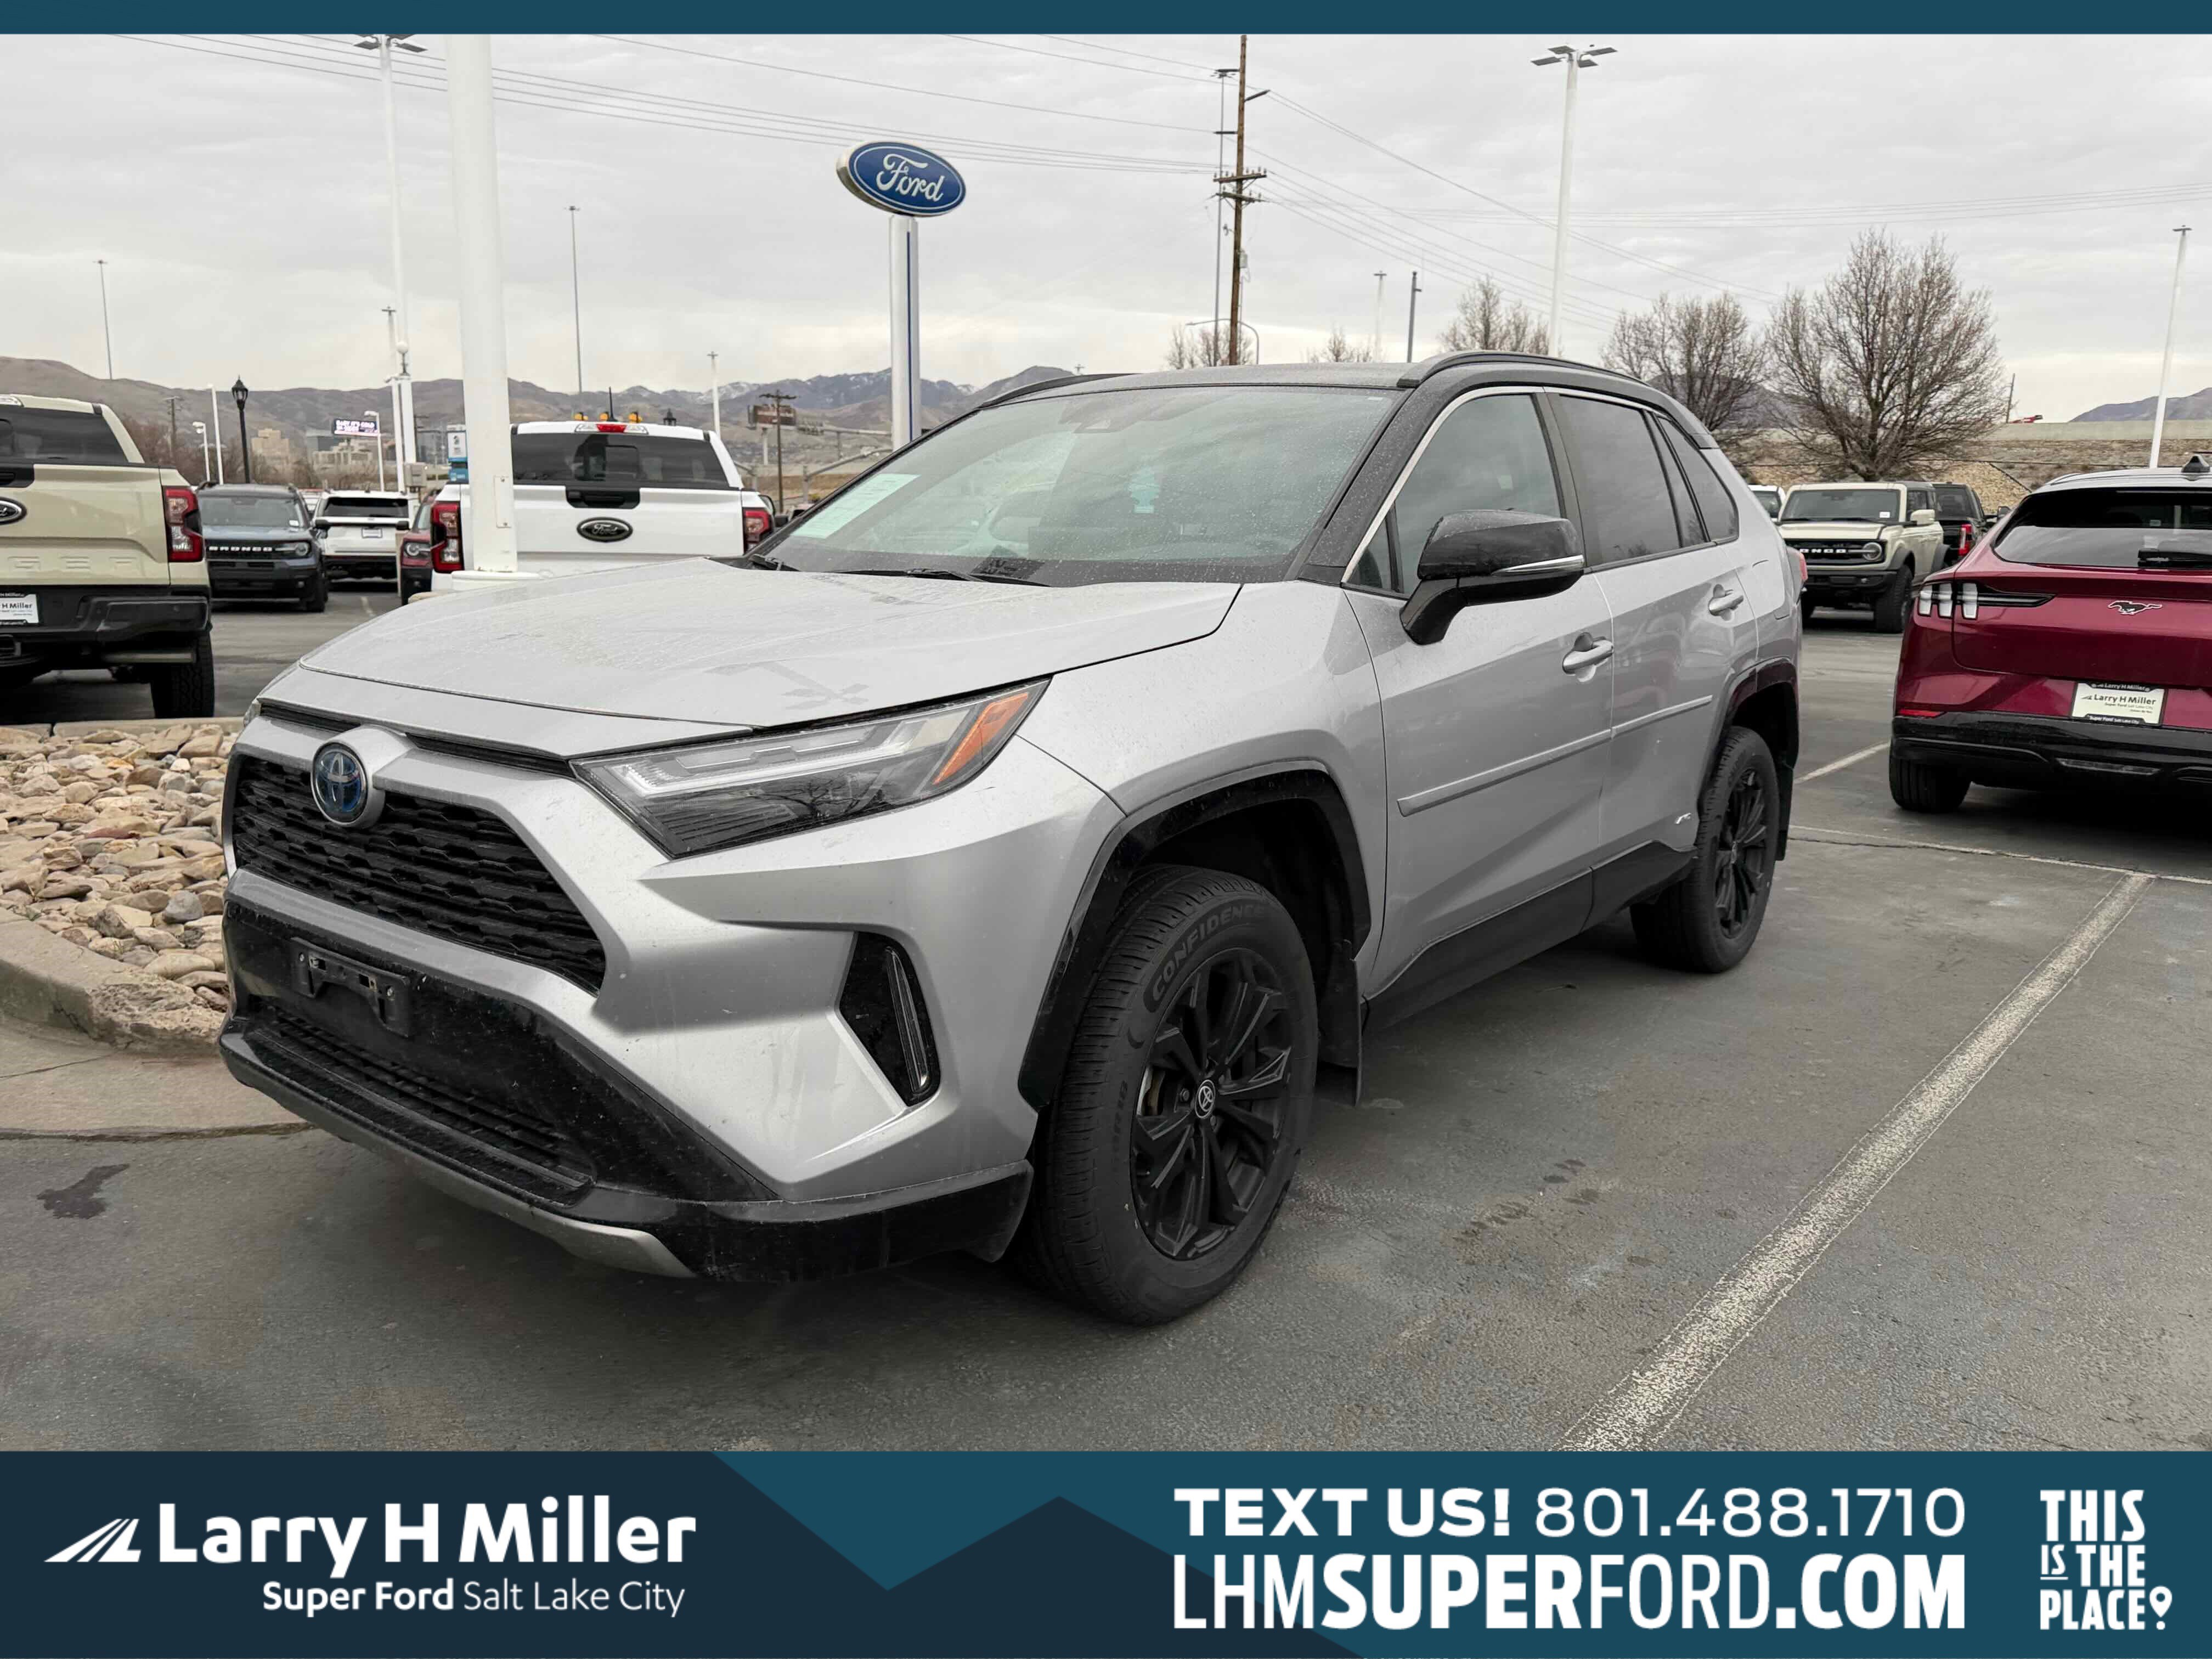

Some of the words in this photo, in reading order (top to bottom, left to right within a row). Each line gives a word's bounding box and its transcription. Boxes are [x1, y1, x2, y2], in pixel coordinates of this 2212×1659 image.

[876, 153, 944, 202] Ford
[2094, 694, 2118, 703] Larry
[2128, 696, 2157, 705] Miller
[1152, 904, 1264, 1002] CONFIDENCE
